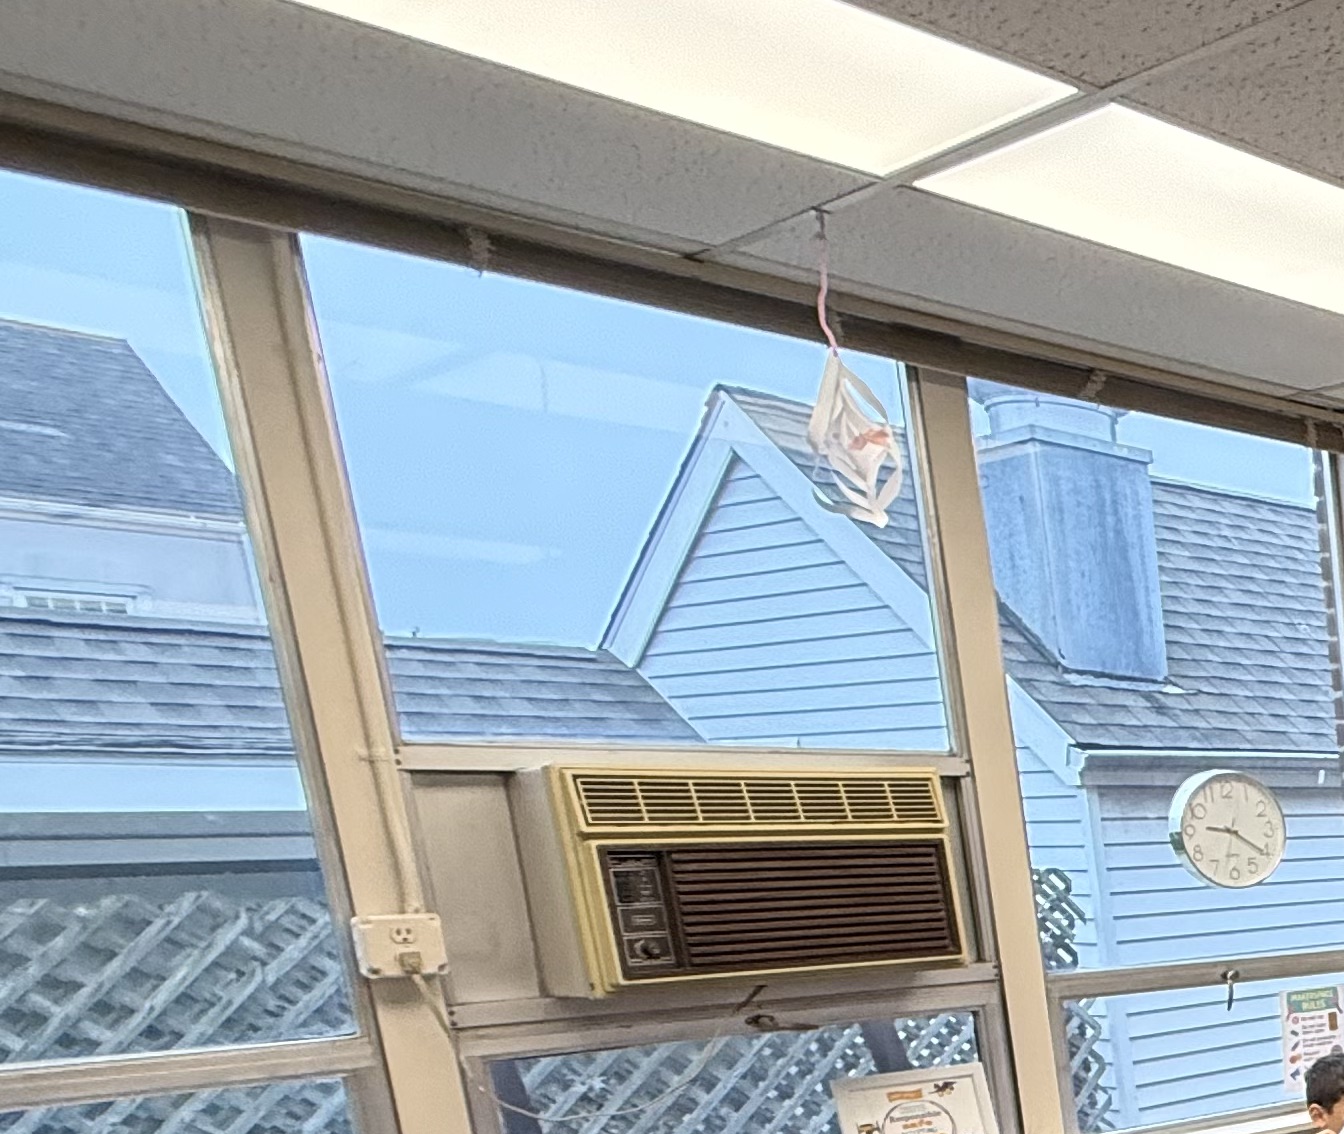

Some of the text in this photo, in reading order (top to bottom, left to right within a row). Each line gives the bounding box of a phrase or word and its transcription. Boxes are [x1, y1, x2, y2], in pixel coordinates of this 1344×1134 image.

[1189, 802, 1207, 820] 10
[1255, 799, 1267, 818] 2
[1183, 823, 1196, 841] 9
[1263, 820, 1276, 839] 3
[1192, 843, 1204, 862] 8
[1209, 858, 1220, 876] 7
[1229, 865, 1241, 881] 6
[1247, 857, 1259, 875] 5
